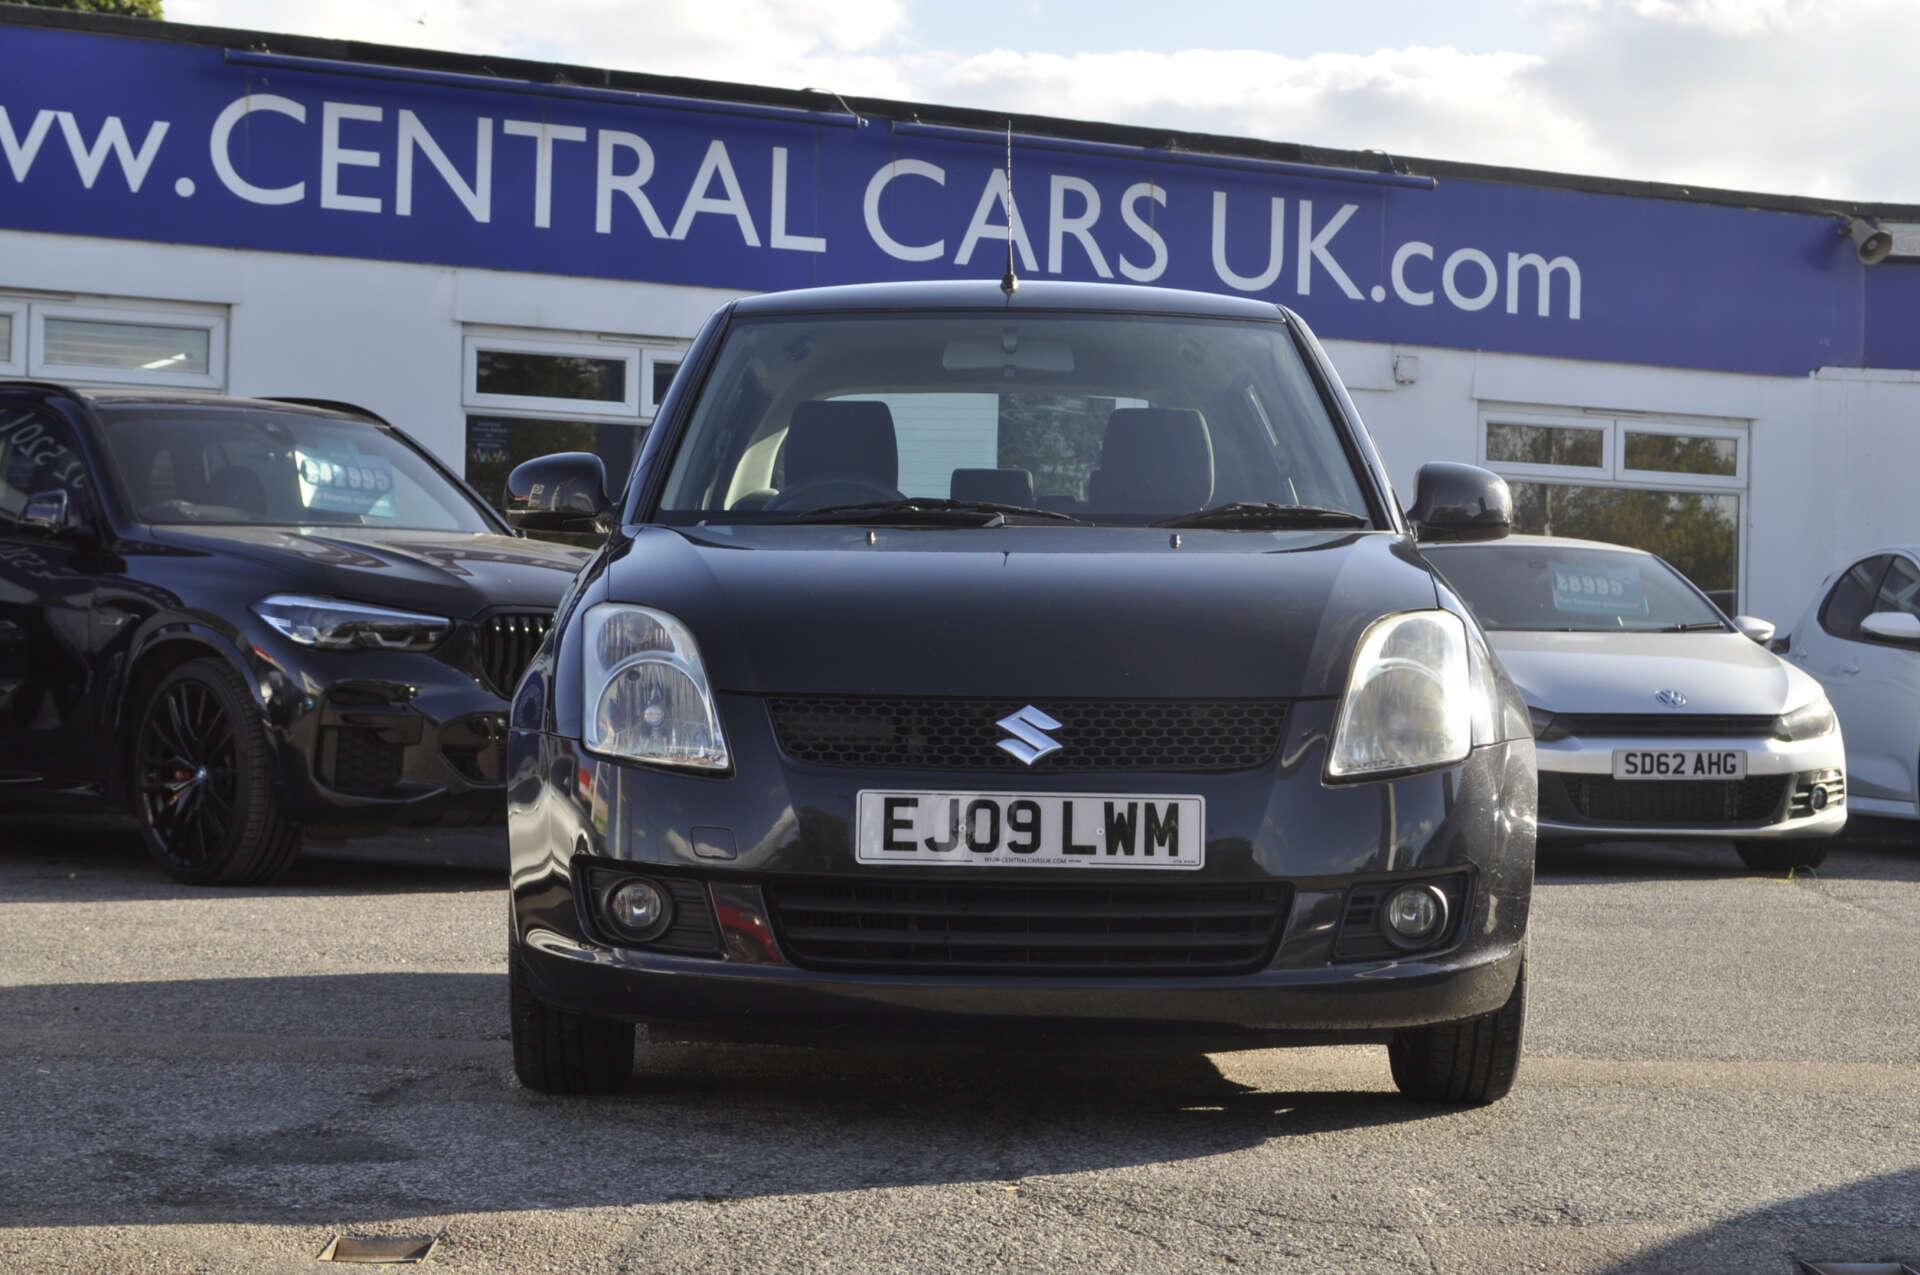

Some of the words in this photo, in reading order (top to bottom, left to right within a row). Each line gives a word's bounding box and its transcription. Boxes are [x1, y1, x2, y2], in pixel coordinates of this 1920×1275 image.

[863, 159, 1169, 283] CARS
[1211, 191, 1582, 321] UK.com
[1625, 753, 1685, 775] SD62
[1693, 753, 1737, 775] AHG
[883, 797, 1042, 855] EJ09
[1062, 801, 1179, 857] LWM
